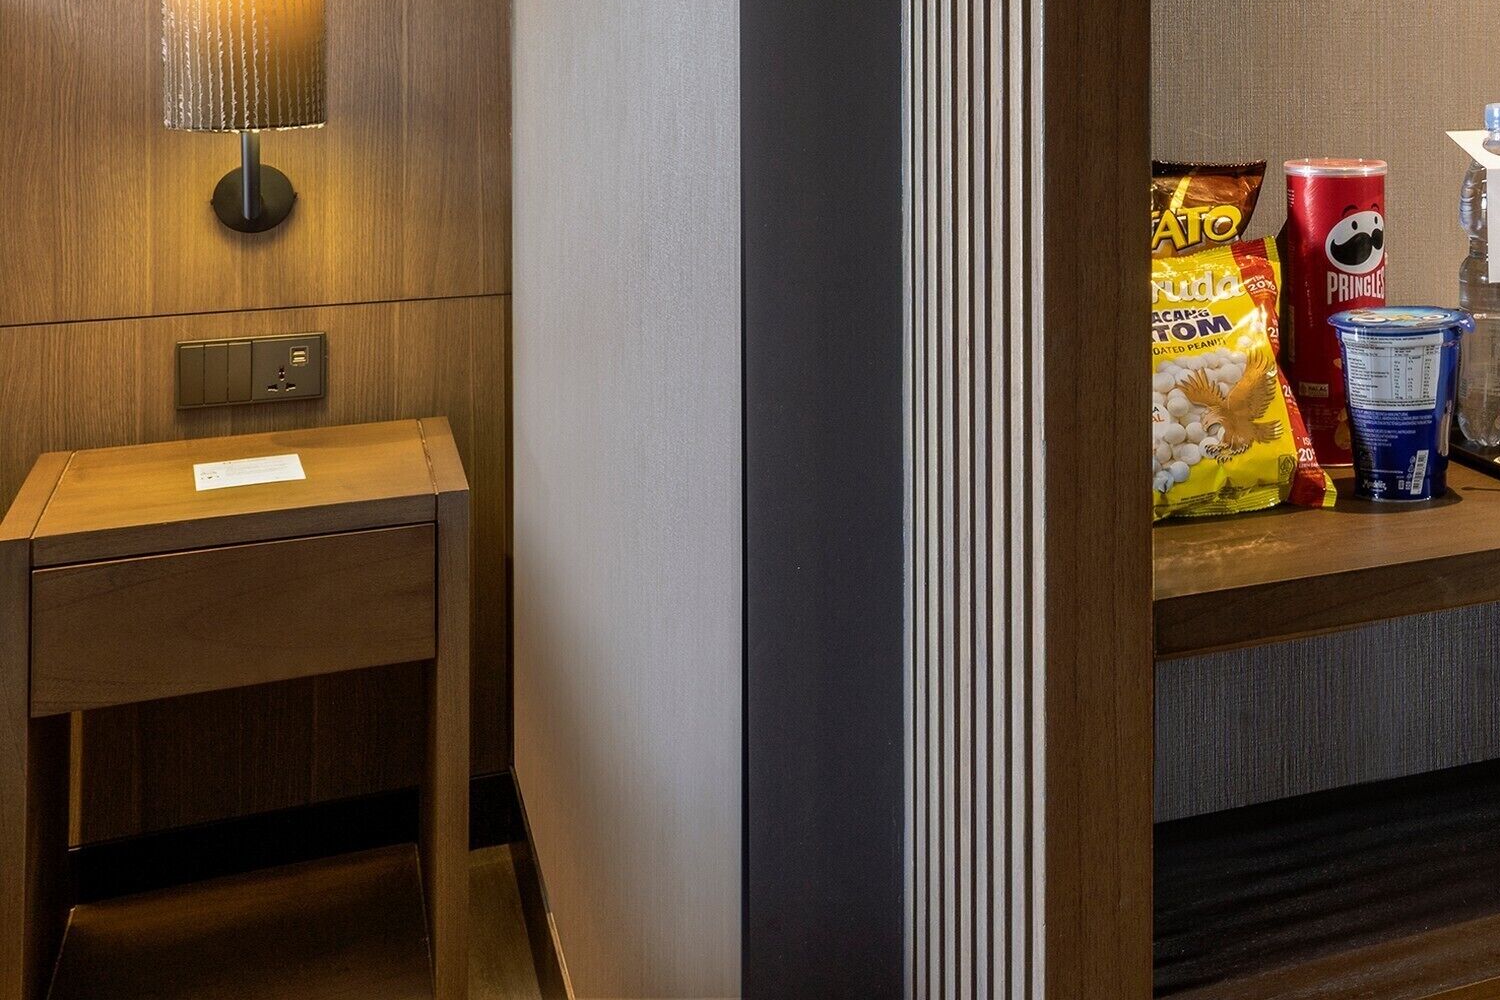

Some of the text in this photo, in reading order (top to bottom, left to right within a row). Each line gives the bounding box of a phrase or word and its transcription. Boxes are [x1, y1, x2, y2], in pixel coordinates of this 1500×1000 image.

[1151, 204, 1242, 251] ATO
[1247, 279, 1276, 292] 20%
[1326, 266, 1385, 305] PRINGLES
[1151, 315, 1233, 344] TOM
[1267, 326, 1279, 338] 2
[1151, 345, 1185, 356] OATED
